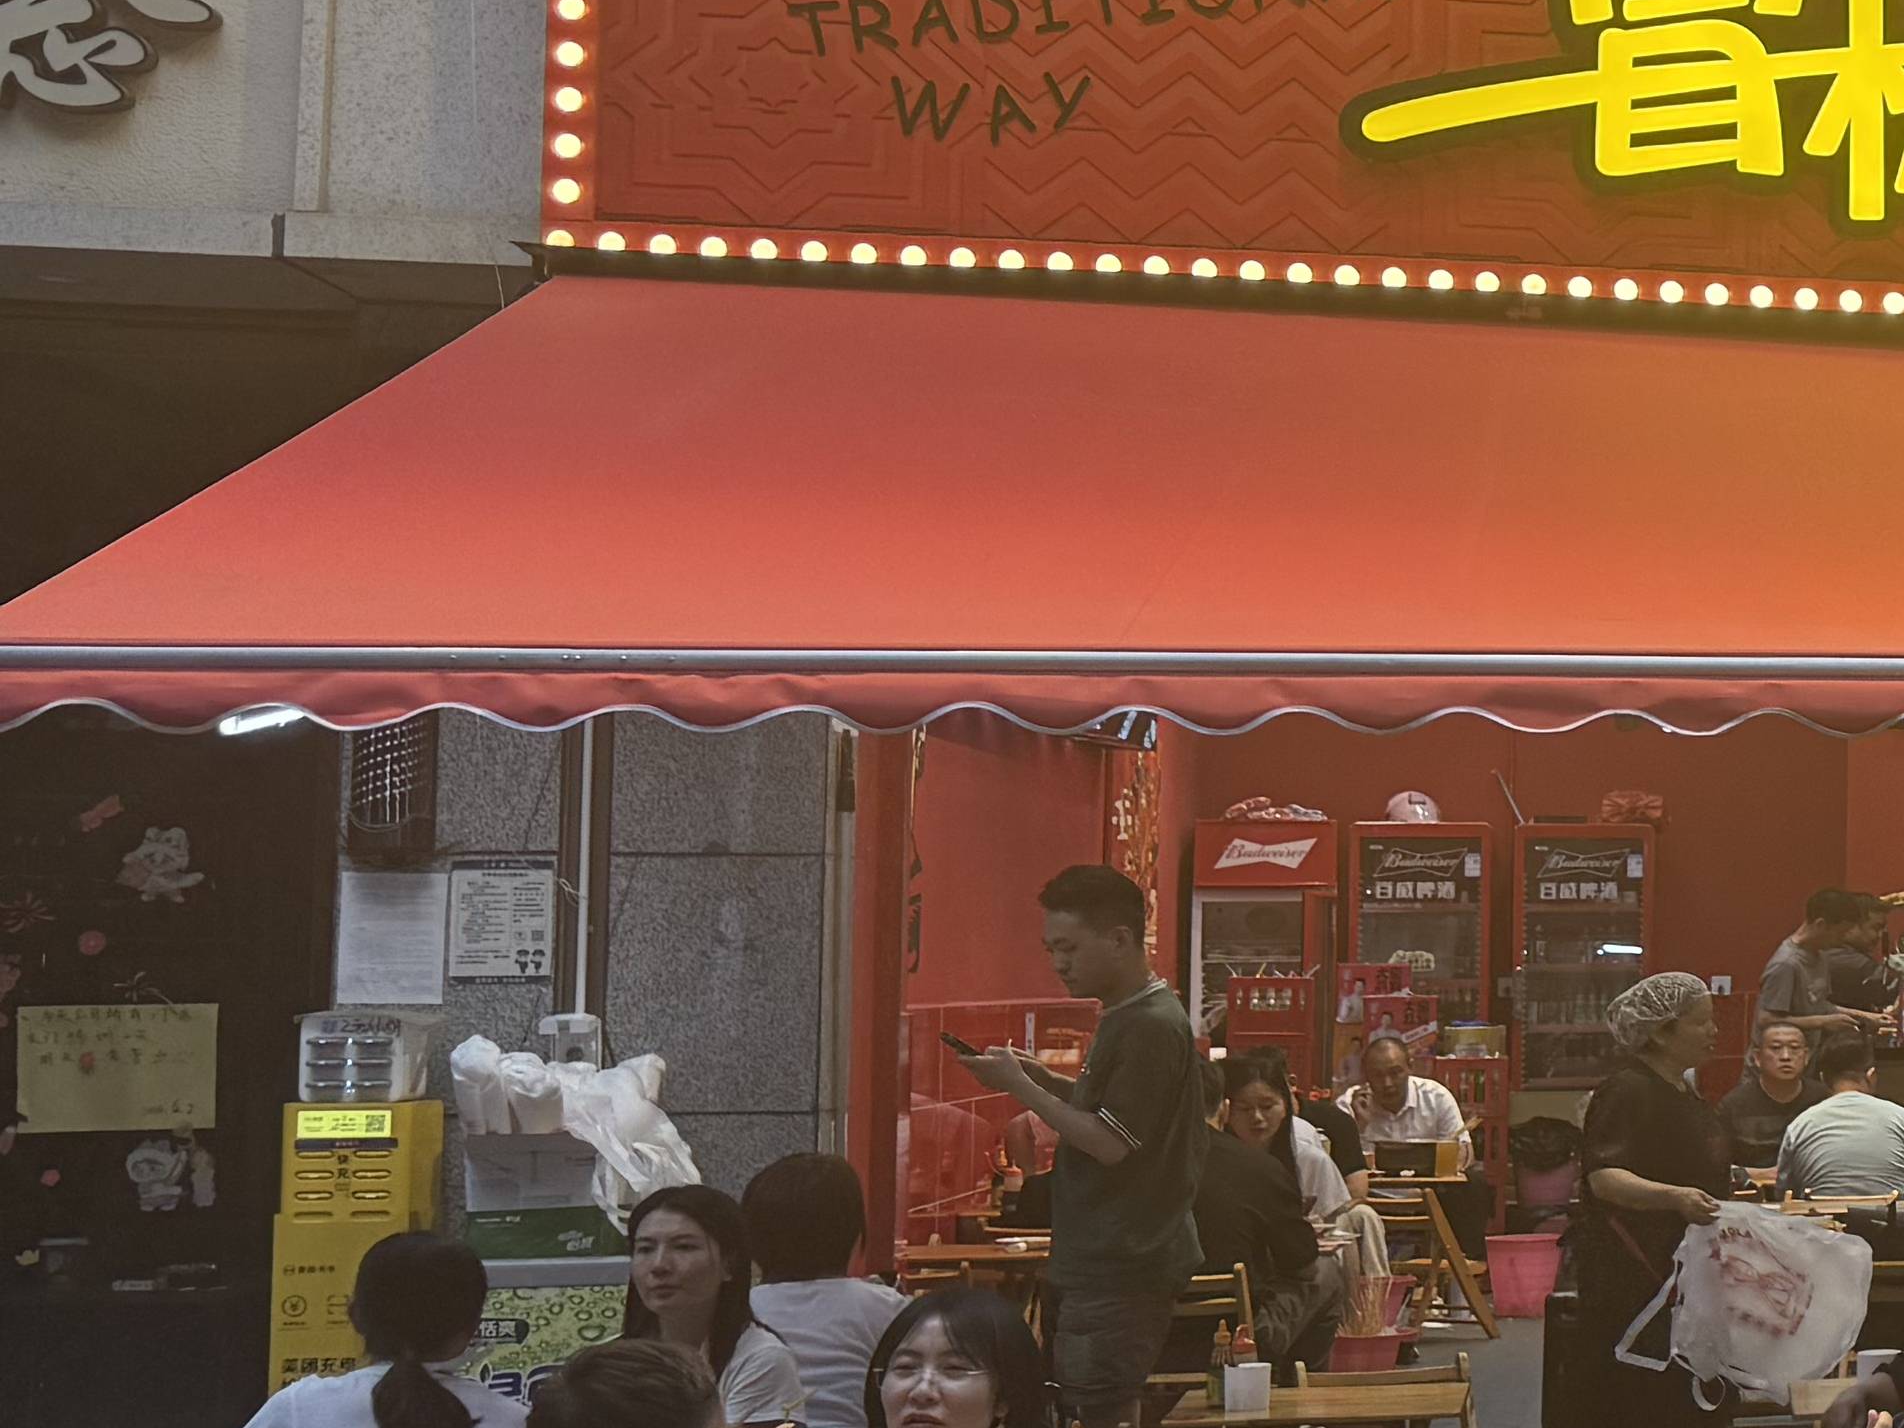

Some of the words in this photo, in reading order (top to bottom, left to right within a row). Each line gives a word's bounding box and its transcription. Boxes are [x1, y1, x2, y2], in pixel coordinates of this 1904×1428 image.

[889, 71, 1092, 149] WAY
[1226, 840, 1308, 862] Budweiser
[1385, 851, 1465, 872] Budweiser
[1551, 852, 1627, 873] Budweiser
